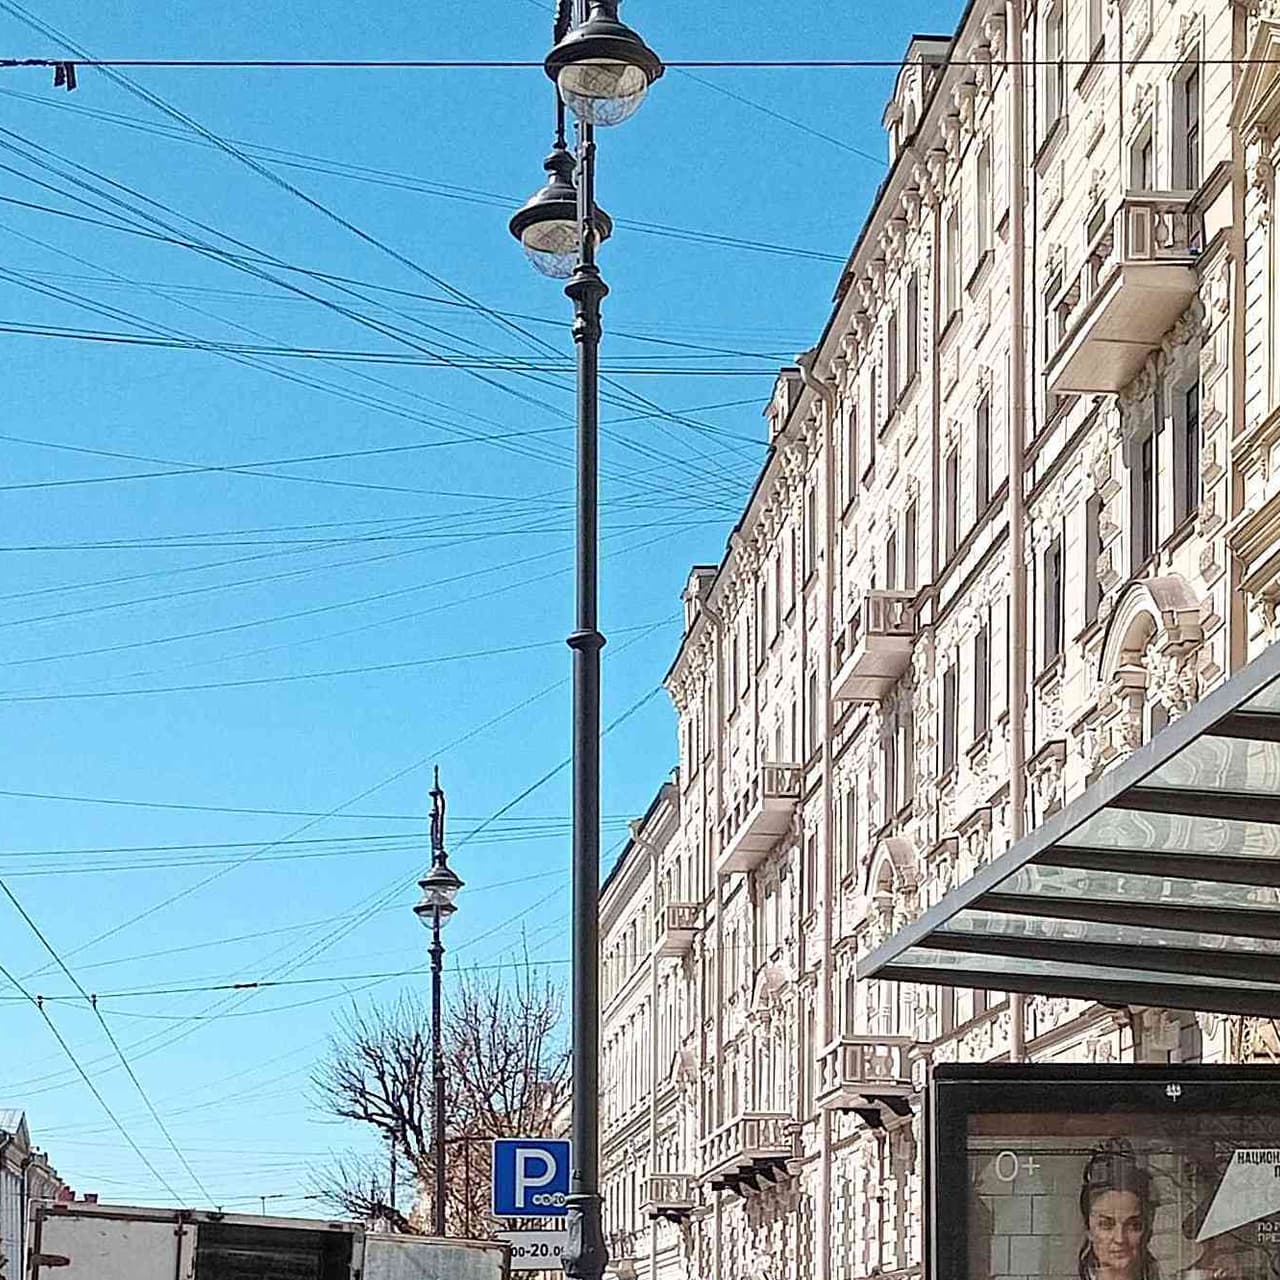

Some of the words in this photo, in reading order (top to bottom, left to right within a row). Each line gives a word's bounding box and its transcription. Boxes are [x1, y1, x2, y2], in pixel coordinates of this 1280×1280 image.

[515, 1148, 557, 1208] P
[995, 1151, 1041, 1181] 0+
[1257, 1222, 1272, 1231] ПО
